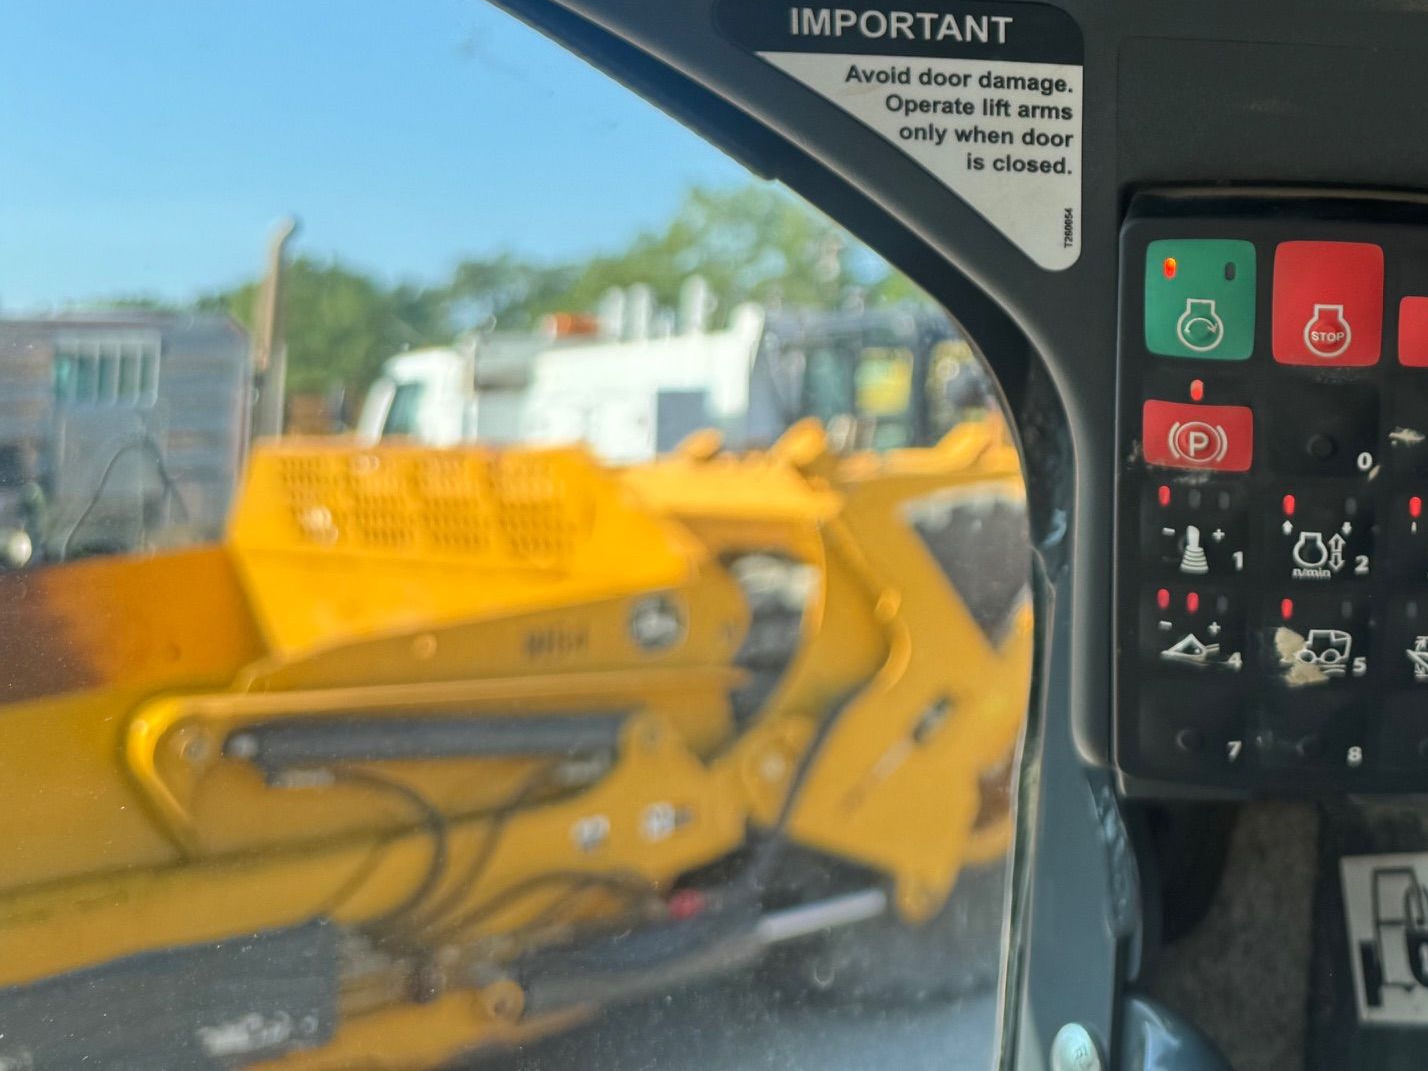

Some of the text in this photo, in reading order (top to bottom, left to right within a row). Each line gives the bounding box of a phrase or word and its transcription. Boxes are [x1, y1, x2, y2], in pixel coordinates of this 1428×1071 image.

[789, 7, 1013, 45] IMPORTANT
[845, 64, 1074, 96] Avoid door damage.
[885, 94, 1073, 120] Operate lift arms
[899, 122, 1074, 147] only when door
[966, 152, 1073, 175] is closed.
[1311, 331, 1345, 342] STOP
[1189, 430, 1208, 457] P
[1232, 551, 1244, 571] 1
[1355, 554, 1369, 574] 2
[1292, 567, 1331, 579] n/min
[1227, 651, 1243, 670] 4
[1352, 657, 1367, 678] 5
[1228, 740, 1243, 762] 7
[1347, 745, 1363, 766] 8
